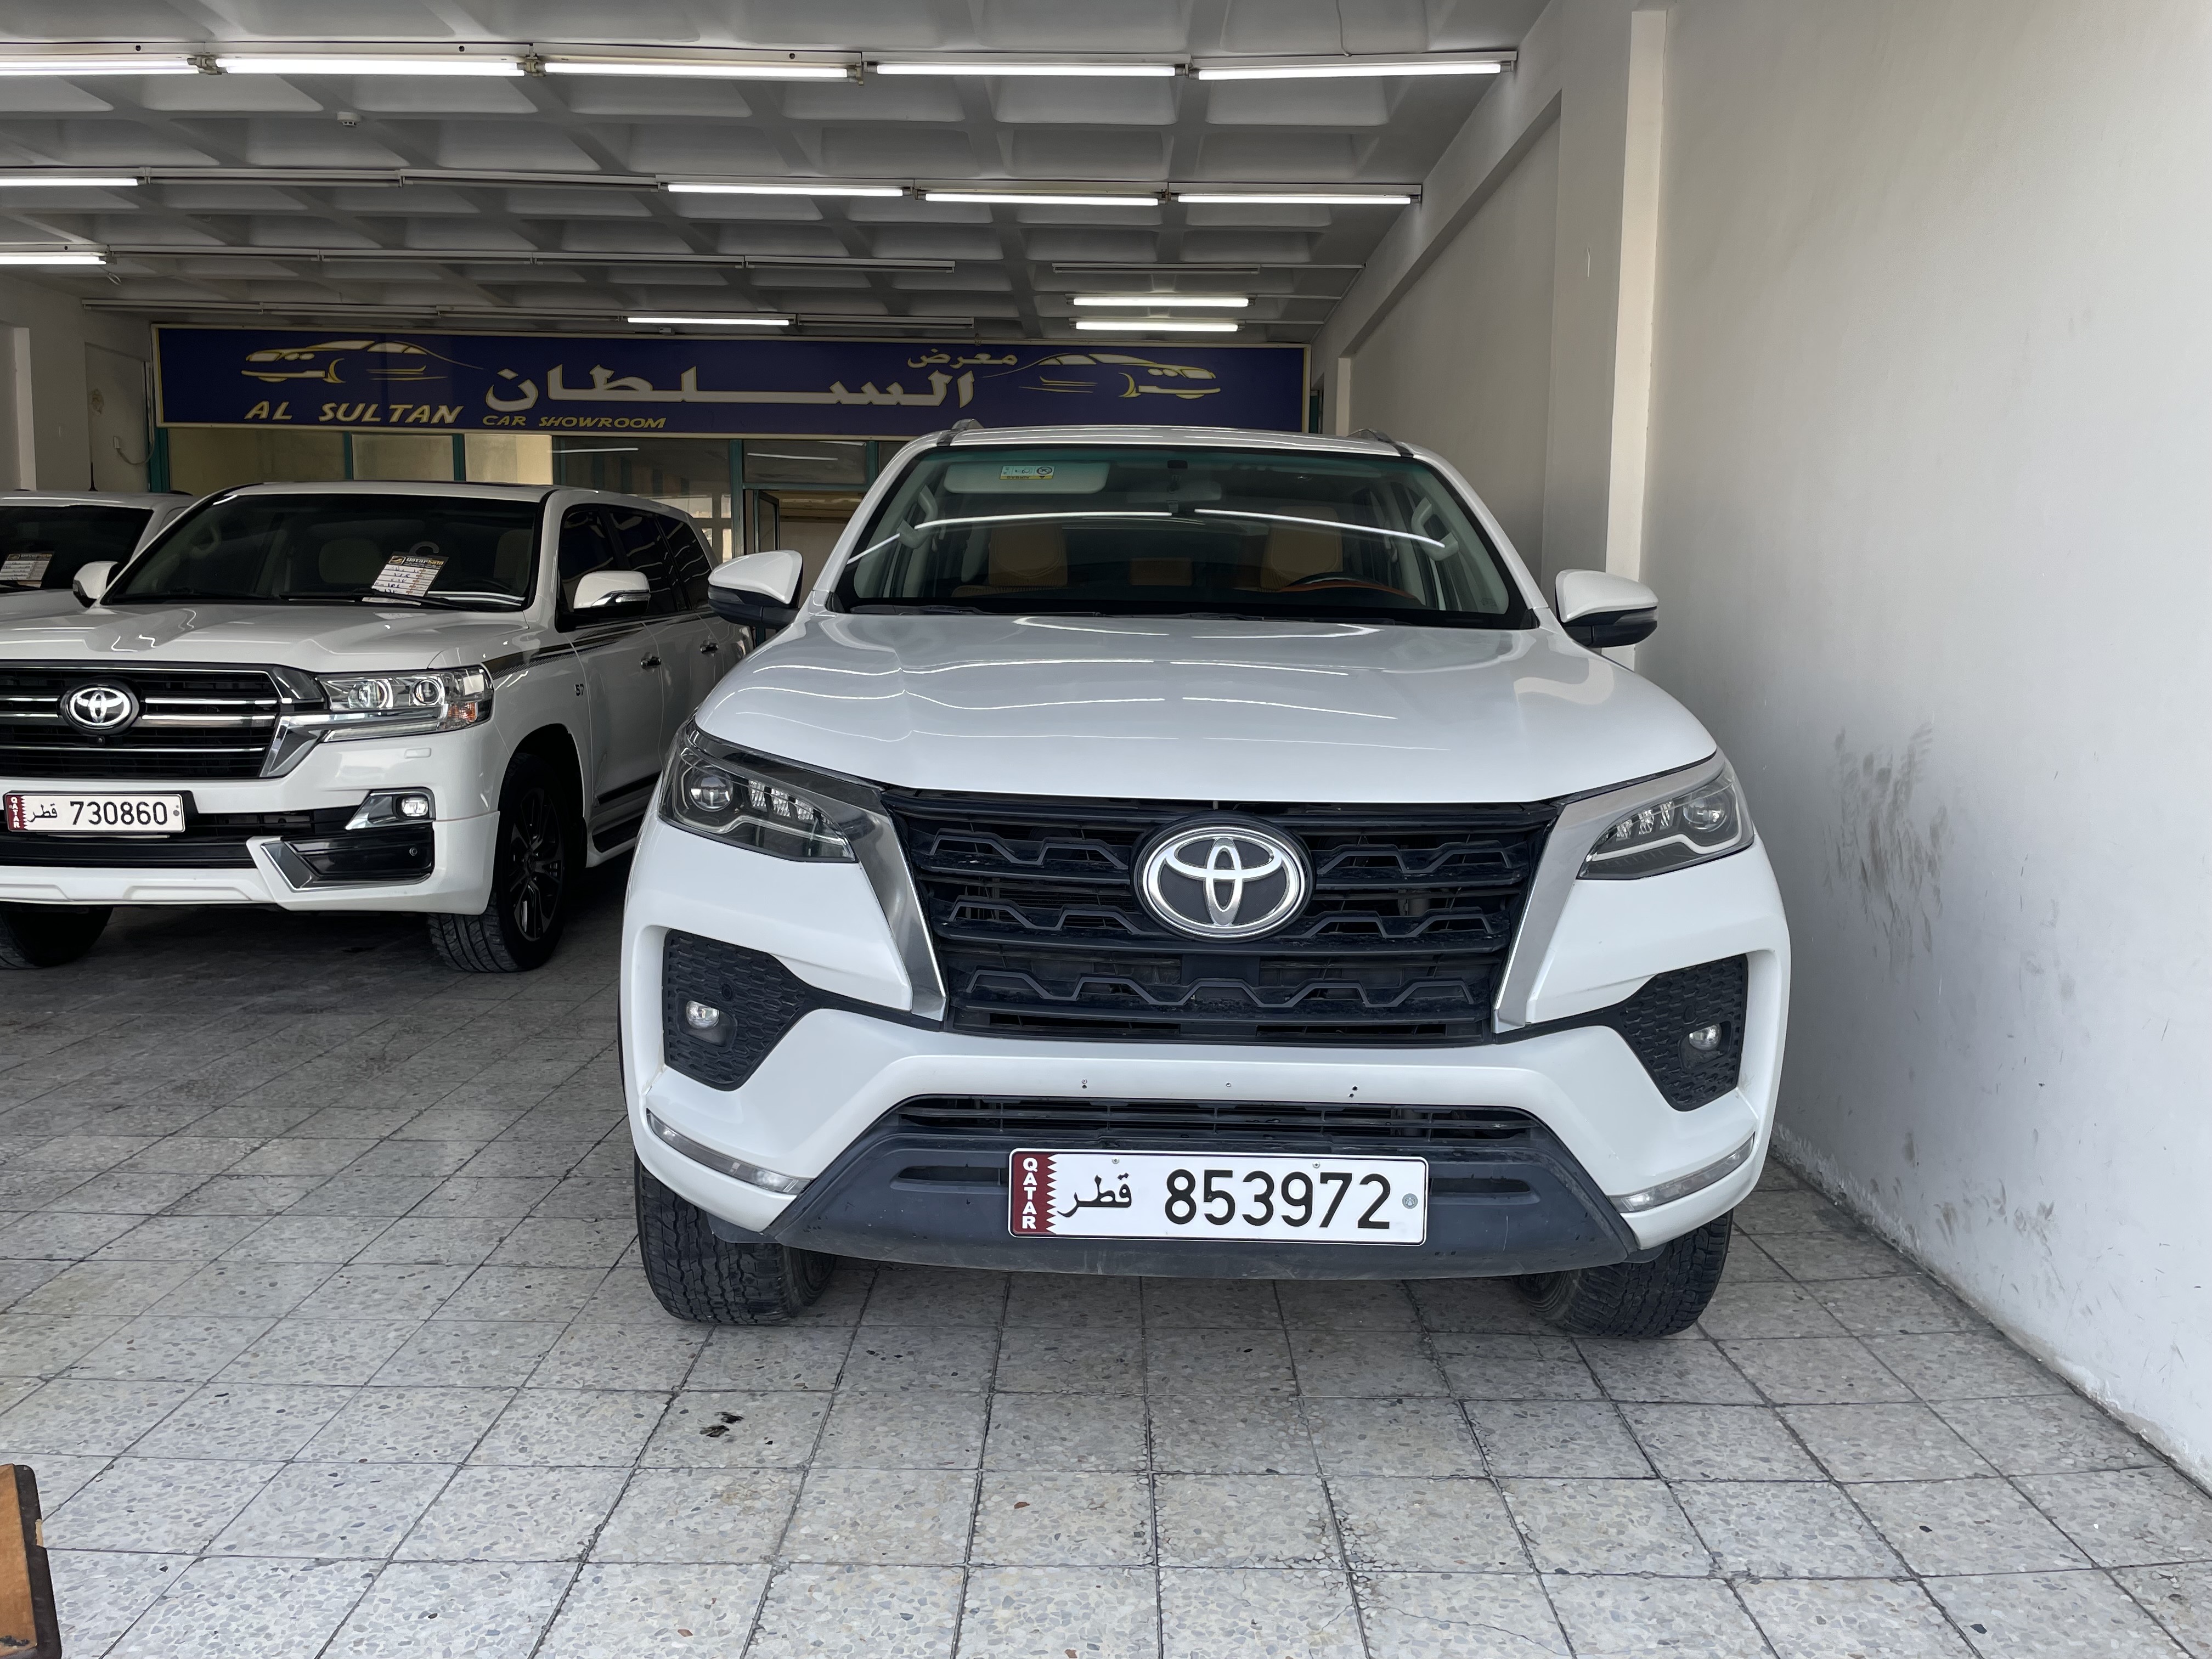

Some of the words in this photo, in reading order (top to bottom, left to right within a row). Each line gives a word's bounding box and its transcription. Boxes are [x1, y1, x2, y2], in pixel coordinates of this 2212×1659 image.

[908, 349, 1018, 369] معرض
[486, 364, 975, 412] السلطان
[245, 400, 292, 420] AL
[319, 403, 464, 424] SULTAN
[482, 415, 527, 427] CAR
[539, 416, 665, 428] SHOWROOM
[10, 797, 20, 828] QATAR
[27, 803, 58, 822] قطر
[70, 801, 167, 825] 730860
[1022, 1158, 1037, 1229] QATAR
[1058, 1173, 1132, 1217] قطر
[1165, 1169, 1391, 1229] 853972
